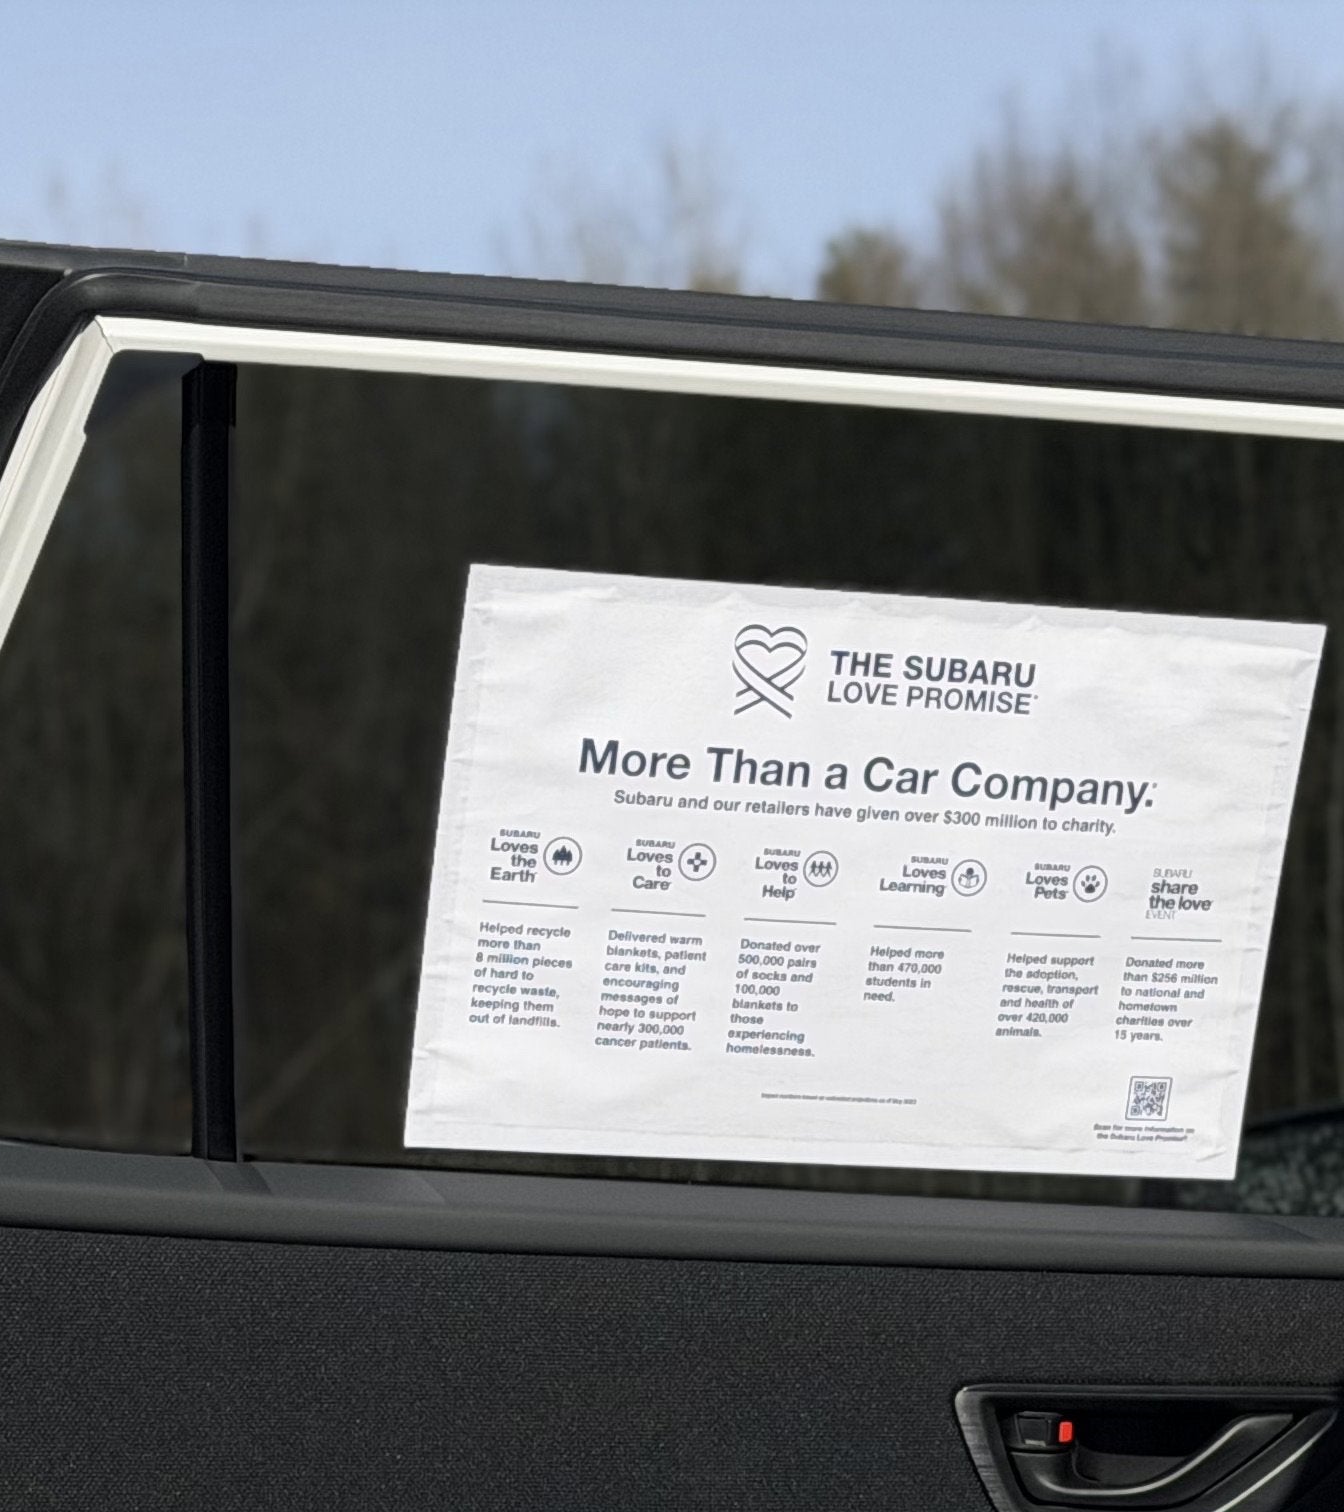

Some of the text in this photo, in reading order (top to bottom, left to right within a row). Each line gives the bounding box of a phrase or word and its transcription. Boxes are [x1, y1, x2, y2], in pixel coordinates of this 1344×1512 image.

[830, 650, 1035, 688] THE SUBARU
[827, 680, 898, 705] LOVE
[578, 737, 690, 779] More
[706, 746, 810, 787] Than
[824, 763, 847, 789] a
[863, 756, 939, 794] Car
[613, 789, 1115, 836] Subaru and our retailers have given over $300 million to charity.
[499, 828, 540, 839] SUBARU
[490, 837, 538, 854] Loves
[635, 838, 675, 849] SUBARU
[626, 847, 673, 863] Loves
[763, 847, 801, 857] SUBARU
[510, 854, 536, 868] the
[754, 856, 798, 871] Loves
[910, 855, 948, 865] SUBARU
[1034, 862, 1070, 871] SUBARU
[655, 864, 671, 877] to
[902, 864, 946, 879] Loves
[1152, 867, 1193, 878] SUBARU
[782, 872, 797, 884] to
[1025, 871, 1068, 886] Loves
[1150, 878, 1198, 895] share
[1148, 894, 1175, 909] the
[1144, 908, 1175, 919] EVENT
[479, 921, 571, 938] Helped recycle
[477, 938, 541, 950] more than
[608, 929, 702, 945] Delivered warm
[606, 944, 706, 961] blankets, patient
[740, 938, 820, 953] Donated over
[869, 945, 944, 959] Helped more
[475, 951, 572, 968] 8 million pieces
[737, 953, 816, 968] 500,000 pairs
[1006, 952, 1094, 967] Helped support
[1125, 956, 1204, 969] Donated more
[473, 966, 534, 980] of hard to
[604, 961, 686, 975] care kits, and
[867, 960, 942, 974] than 470,000
[1004, 967, 1078, 981] the adoption,
[735, 968, 813, 983] of socks and
[865, 976, 931, 988] students in
[1123, 971, 1218, 984] than $256 million
[472, 983, 559, 999] recycle waste,
[602, 977, 679, 992] encouraging
[735, 983, 780, 996] 100,000
[1001, 984, 1099, 997] rescue, transport
[600, 992, 679, 1005] messages of
[863, 991, 895, 1002] need.
[1120, 986, 1205, 999] to national and
[470, 996, 553, 1012] keeping them
[731, 998, 798, 1011] blankets to
[999, 997, 1074, 1008] and health of
[1117, 1000, 1177, 1012] hometown
[468, 1013, 560, 1027] out of landfills.
[598, 1004, 696, 1022] hope to support
[729, 1013, 763, 1024] those
[997, 1012, 1068, 1023] over 420,000
[596, 1021, 684, 1035] nearly 300,000
[1115, 1015, 1193, 1027] charities over
[727, 1029, 805, 1044] experiencing
[995, 1026, 1041, 1037] animals.
[1114, 1029, 1163, 1042] 15 years.
[594, 1036, 691, 1050] cancer patients.
[725, 1042, 814, 1056] homelessness.
